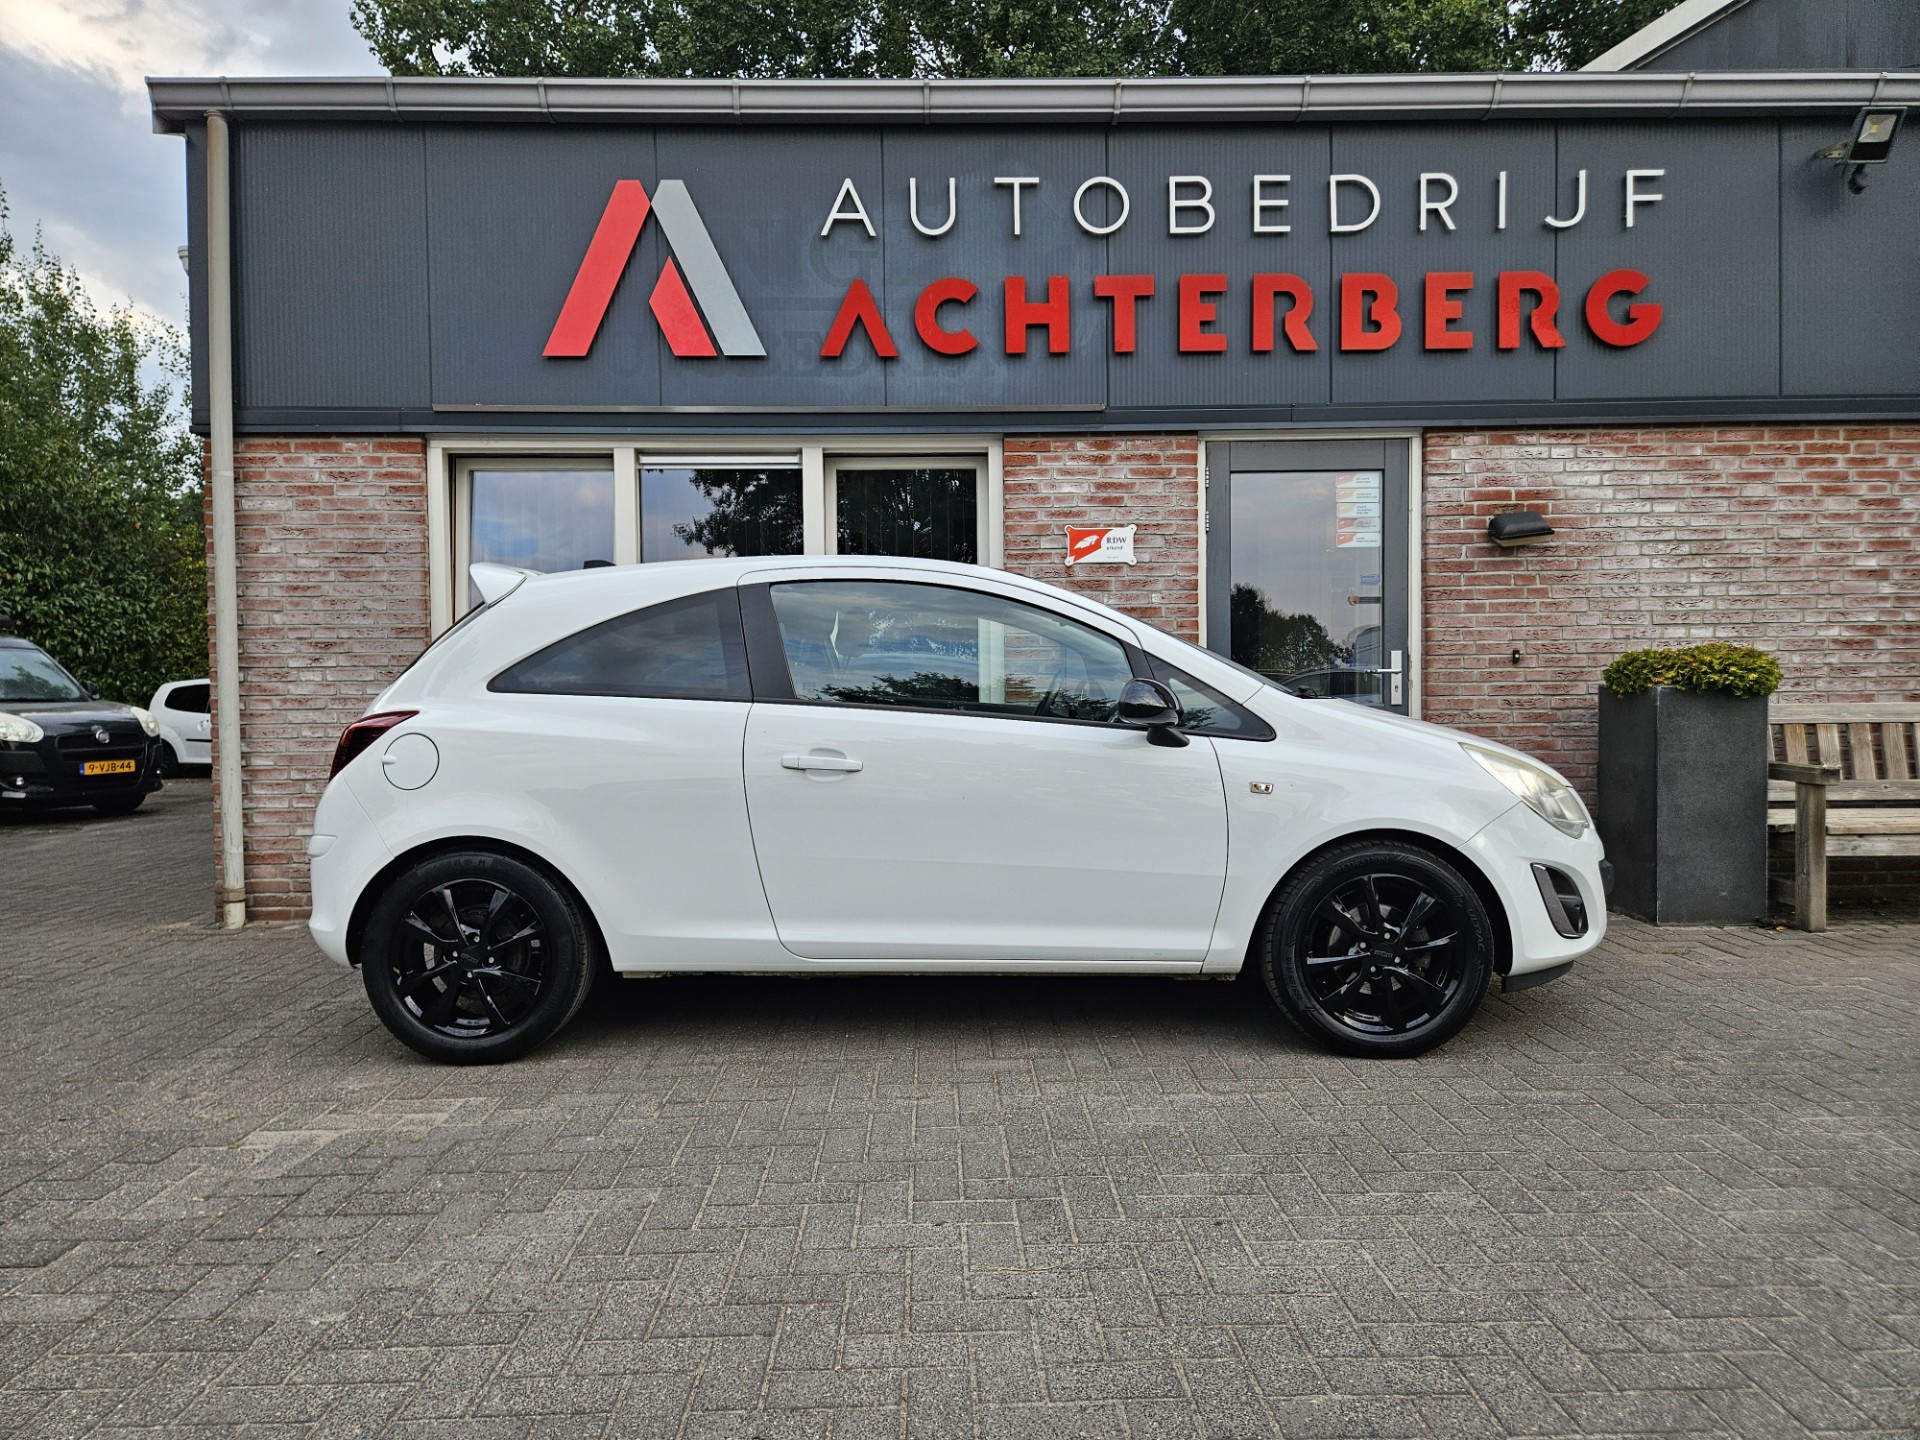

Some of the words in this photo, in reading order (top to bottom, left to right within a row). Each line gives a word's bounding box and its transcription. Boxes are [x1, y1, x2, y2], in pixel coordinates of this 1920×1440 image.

[820, 168, 1666, 237] AUTOBEDRIJF
[818, 268, 1663, 358] ACHTERBERG
[1106, 536, 1127, 544] RDW
[88, 761, 132, 773] 9-VJB-44
